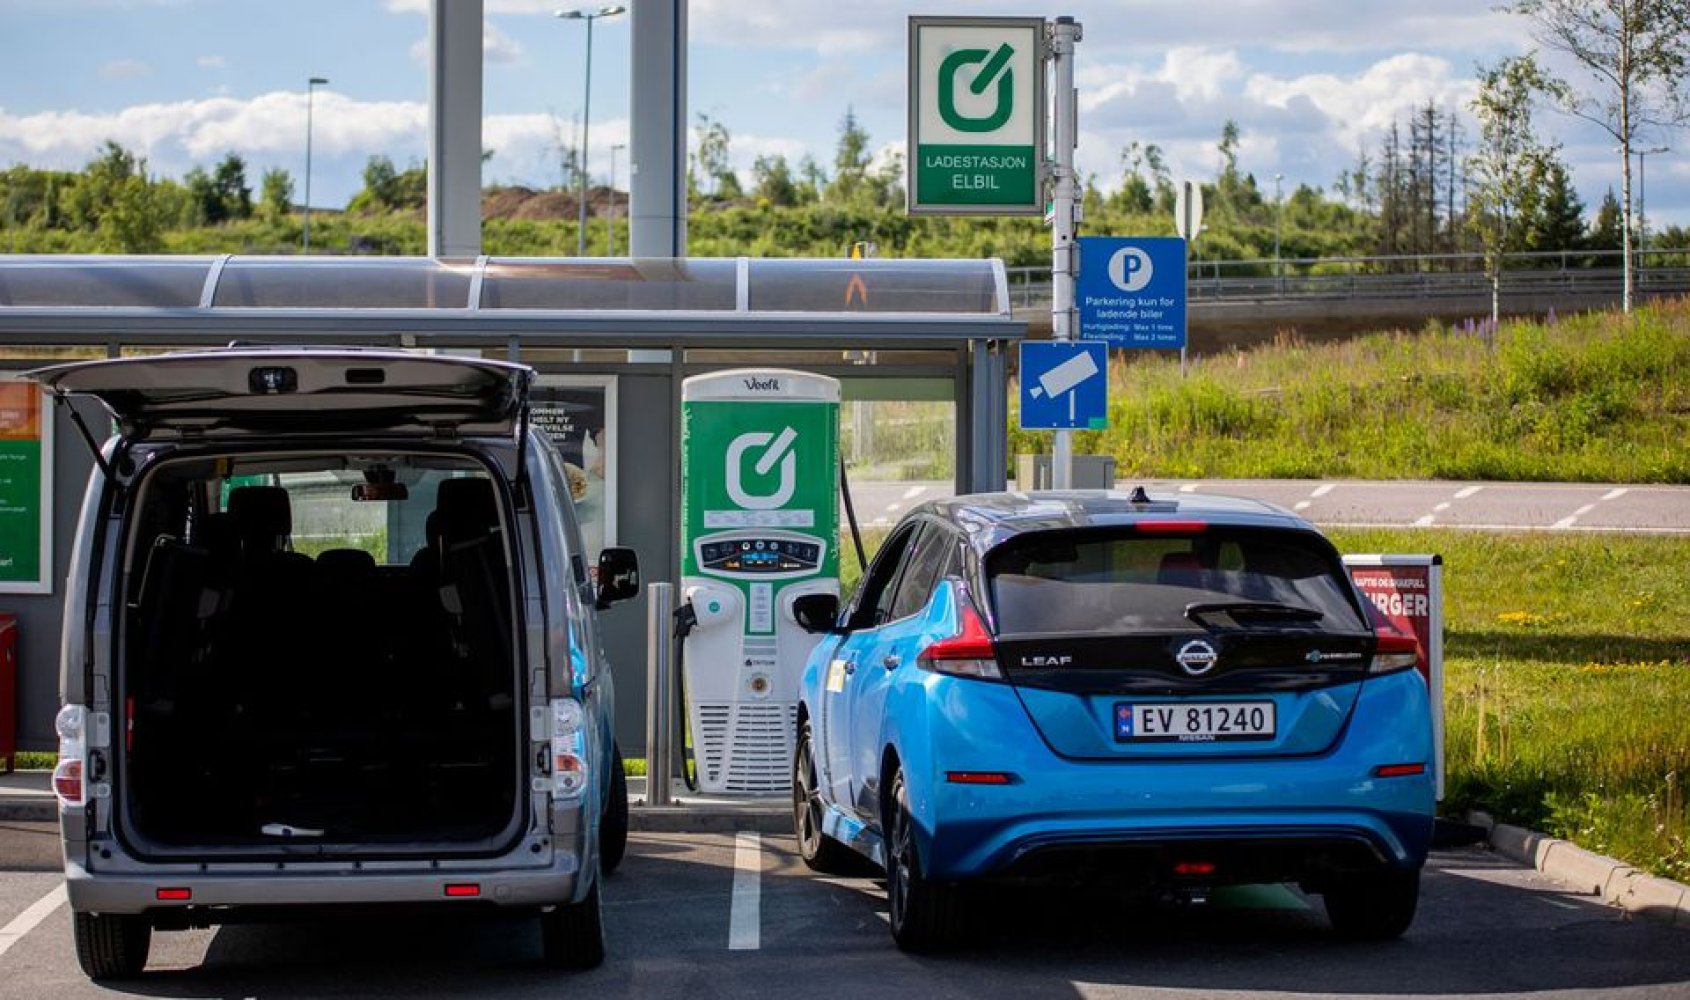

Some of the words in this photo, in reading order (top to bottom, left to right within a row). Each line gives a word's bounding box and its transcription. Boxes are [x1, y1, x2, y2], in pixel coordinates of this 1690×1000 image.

[926, 156, 1026, 168] LADESTASJON
[952, 174, 1000, 189] ELBIL
[1123, 255, 1142, 284] P
[1085, 296, 1136, 308] Parkering
[1138, 296, 1157, 306] kun
[1160, 296, 1175, 306] for
[1096, 309, 1138, 318] ladende
[1140, 309, 1163, 318] biler
[744, 377, 780, 391] Veefil
[1021, 656, 1072, 666] LEAF
[1143, 708, 1173, 733] EV
[1186, 707, 1265, 731] 81240
